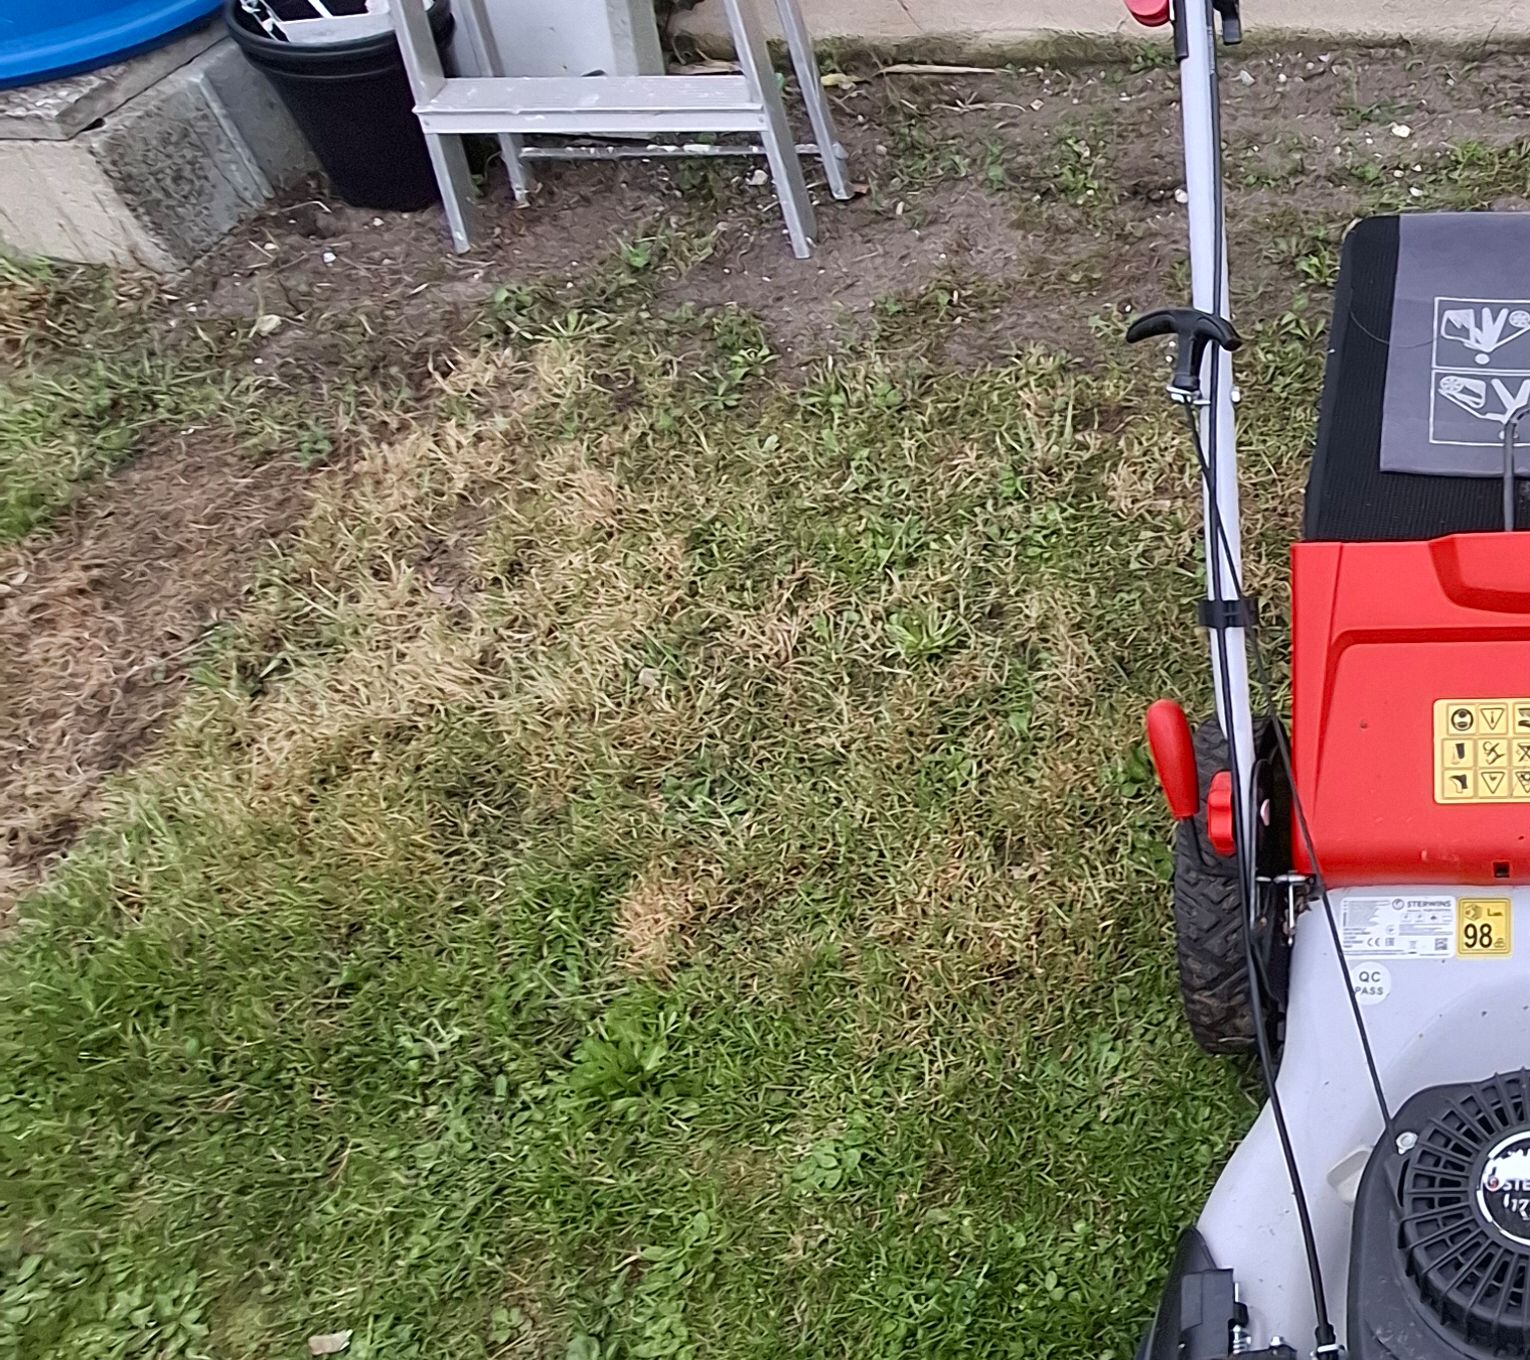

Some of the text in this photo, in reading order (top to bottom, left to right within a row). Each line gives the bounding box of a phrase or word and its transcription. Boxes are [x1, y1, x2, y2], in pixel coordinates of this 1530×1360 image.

[1464, 923, 1493, 949] 98
[1359, 971, 1381, 983] QC
[1354, 986, 1384, 996] PASS
